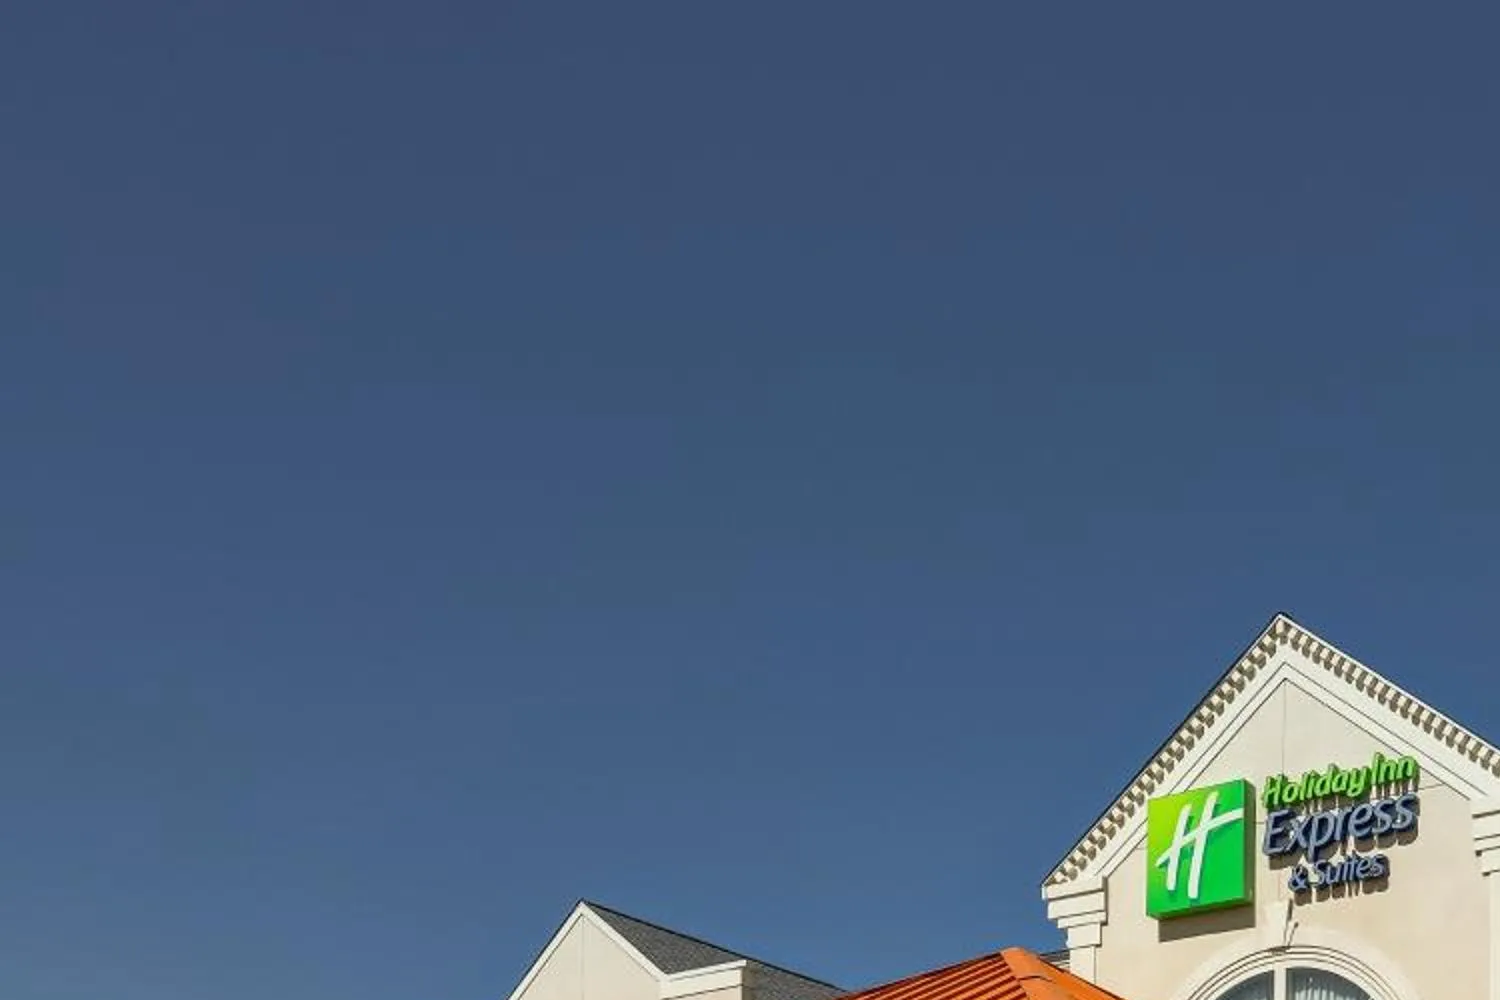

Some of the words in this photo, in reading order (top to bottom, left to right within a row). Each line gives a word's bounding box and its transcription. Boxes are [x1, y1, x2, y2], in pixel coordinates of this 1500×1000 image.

[1262, 763, 1370, 807] Holiday
[1370, 752, 1419, 787] Inn
[1155, 790, 1245, 899] H
[1263, 793, 1419, 860] Express
[1288, 867, 1310, 892] &
[1310, 852, 1388, 887] Suites
